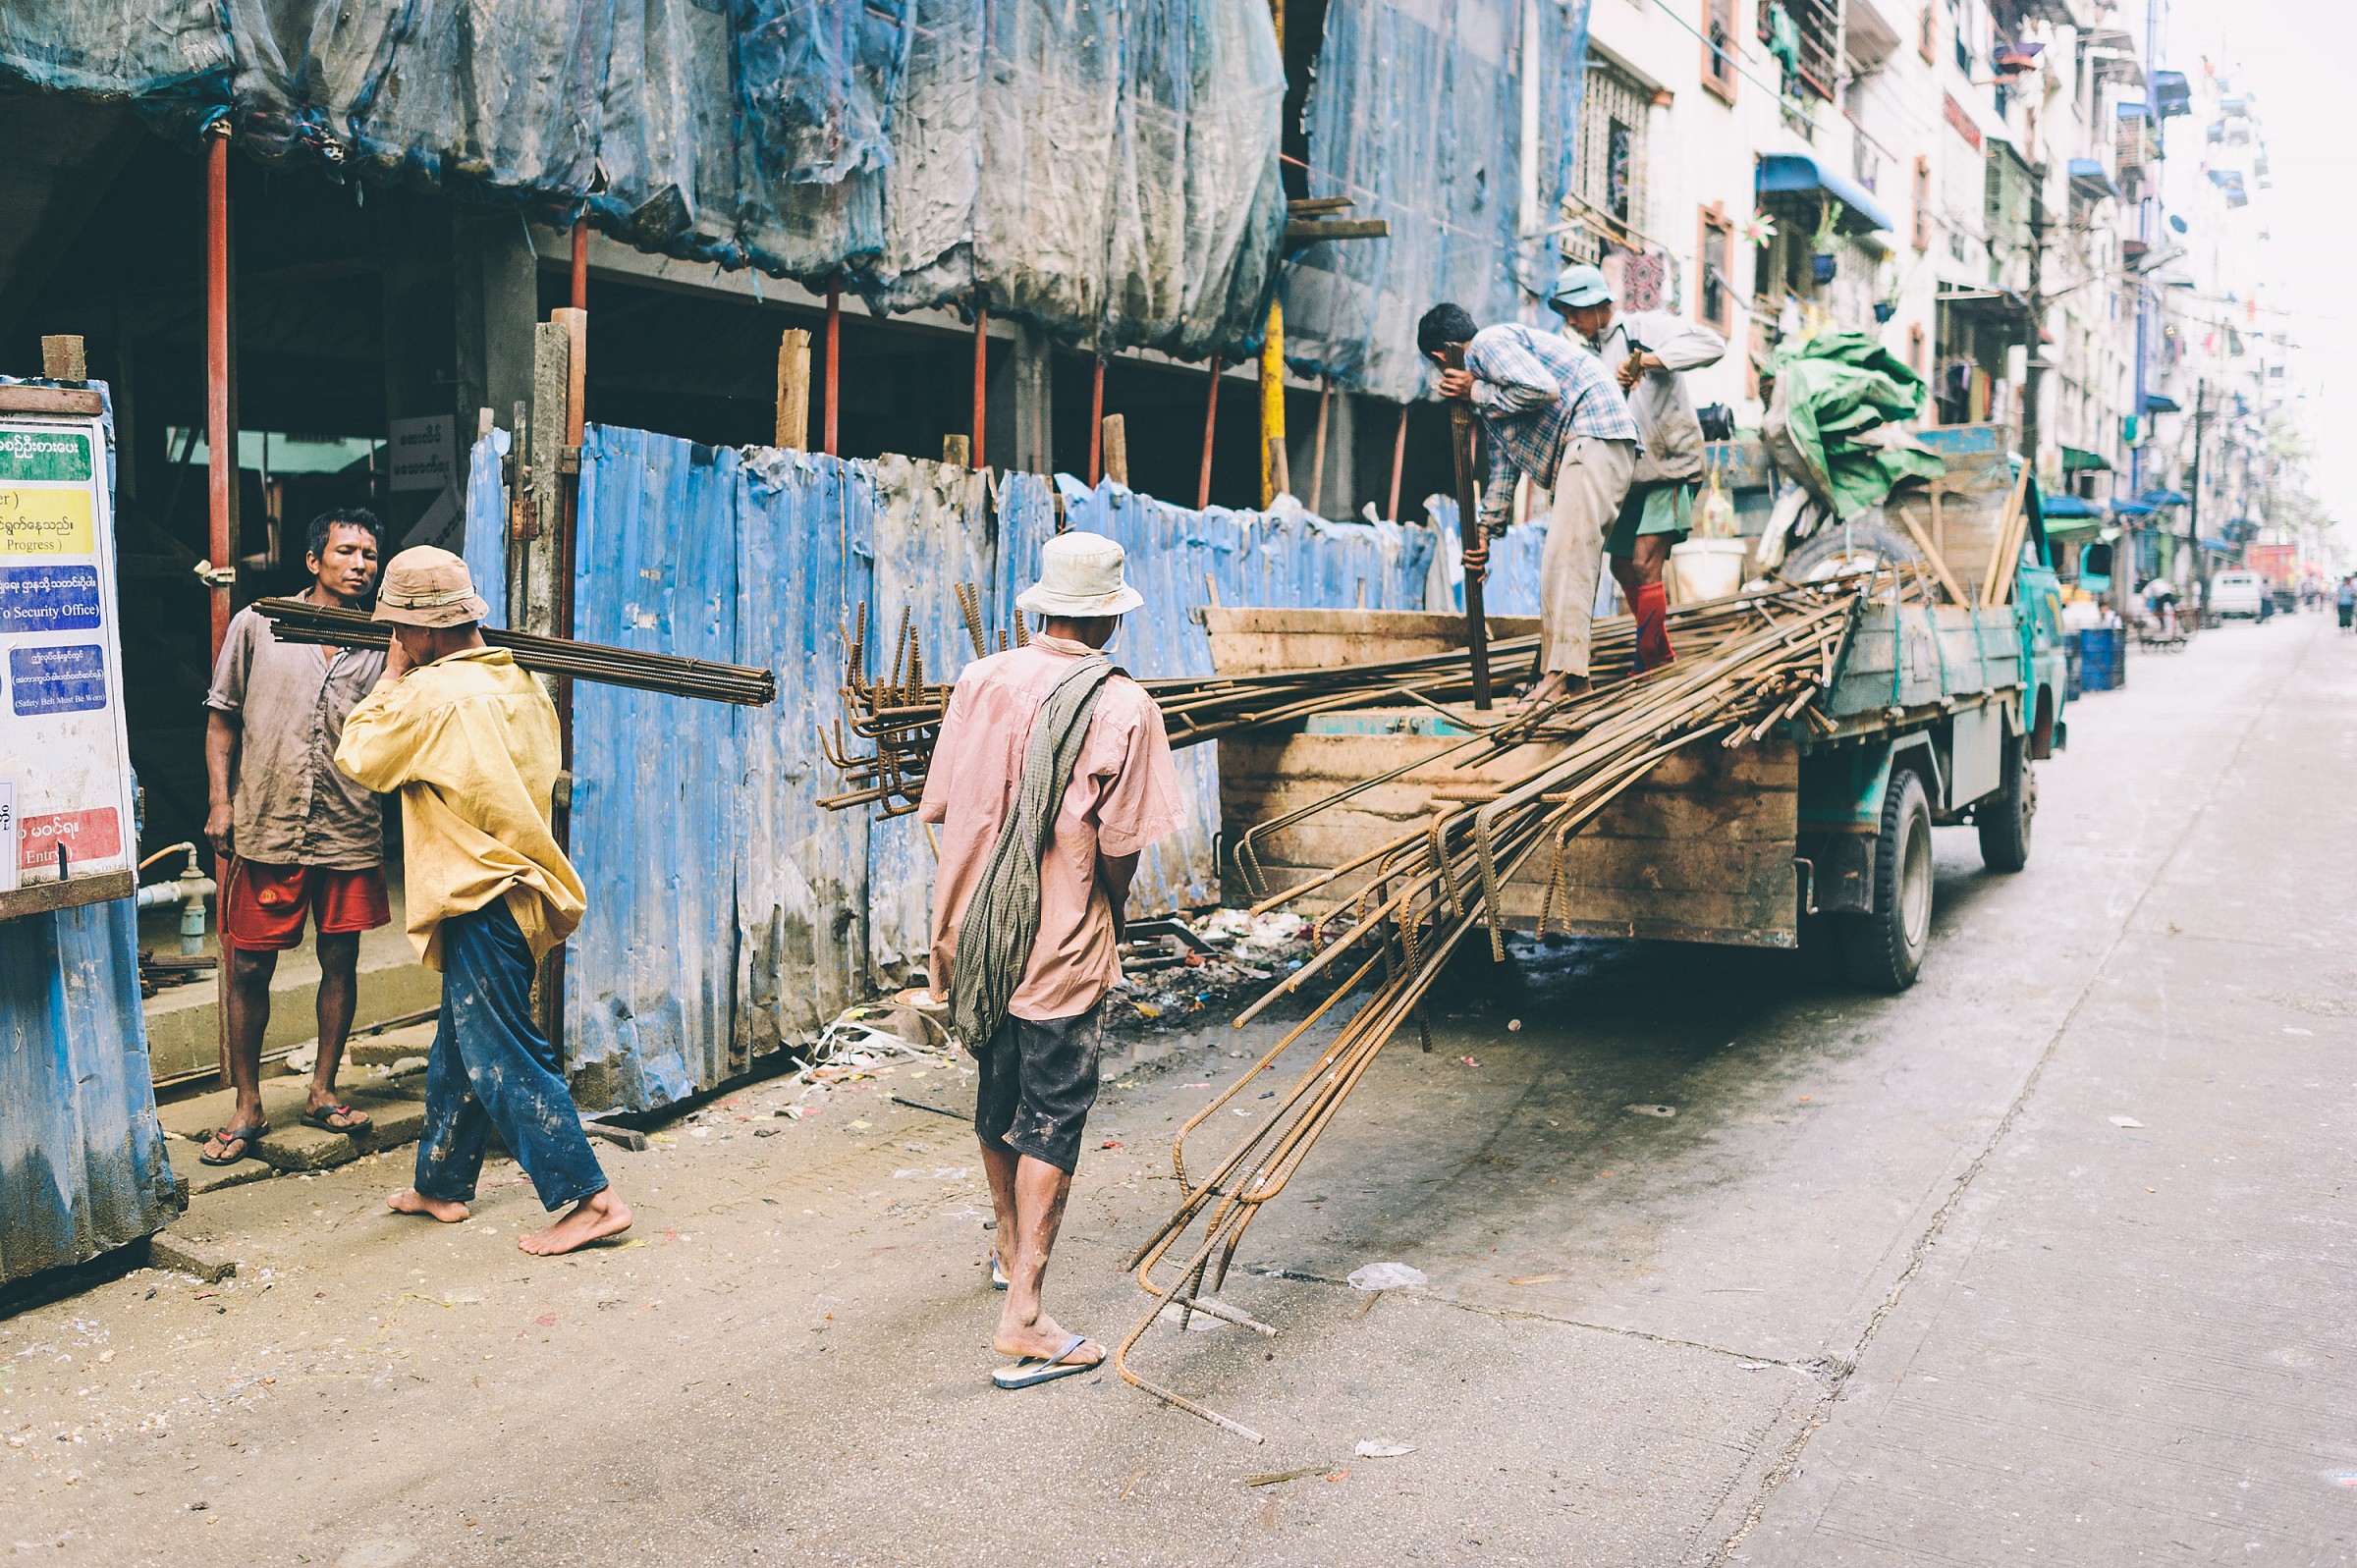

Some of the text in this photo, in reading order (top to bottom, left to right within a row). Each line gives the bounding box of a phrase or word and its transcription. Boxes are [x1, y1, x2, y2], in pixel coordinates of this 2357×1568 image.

[7, 539, 55, 554] Progress
[14, 605, 59, 620] Security
[62, 603, 100, 618] Office)
[15, 698, 39, 709] (Safety
[41, 697, 56, 706] Belt
[56, 696, 74, 705] Must
[85, 693, 106, 703] Worn)
[26, 849, 60, 865] Entry
